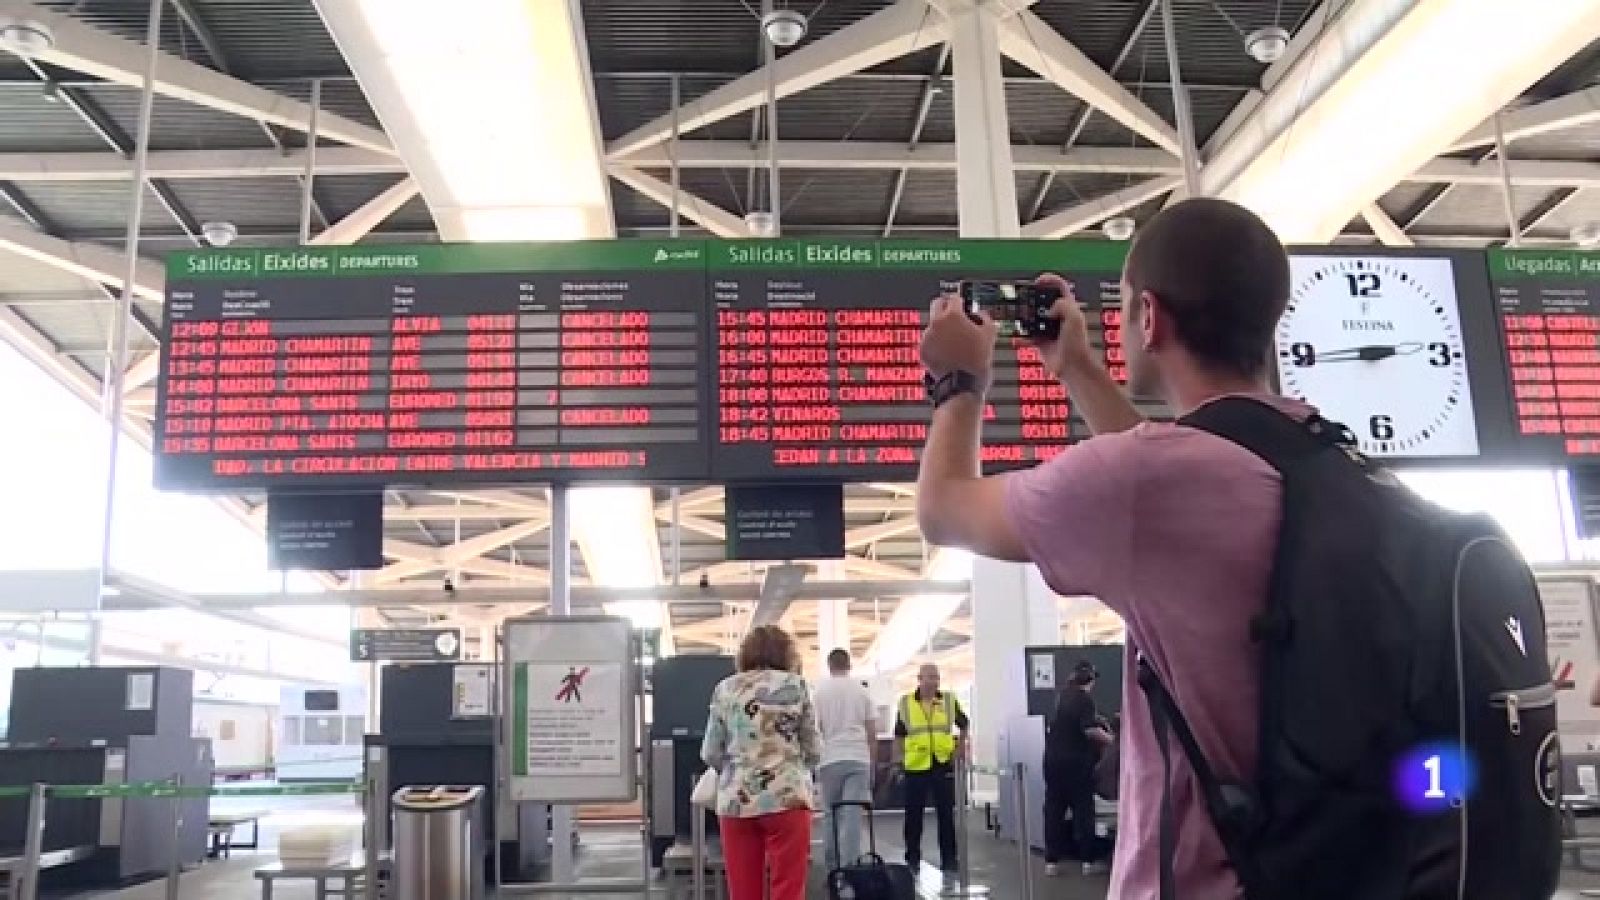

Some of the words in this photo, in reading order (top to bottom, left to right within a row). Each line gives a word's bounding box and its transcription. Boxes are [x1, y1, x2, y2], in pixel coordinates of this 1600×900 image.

[187, 255, 251, 271] Salidas
[264, 253, 328, 270] Eixides
[339, 254, 419, 269] DEPARTURES
[729, 246, 794, 262] Salidas
[806, 245, 872, 261] Eixides
[883, 249, 960, 262] DEPARTURES
[1505, 254, 1571, 275] Llegadas
[1343, 273, 1381, 297] 12
[392, 316, 441, 332] ALVIA
[561, 311, 650, 328] CANCELADO
[719, 310, 767, 326] 15:45
[769, 310, 827, 326] MADRID
[835, 309, 921, 325] CHAMARTIN
[220, 339, 278, 356] MADRID
[392, 335, 421, 351] AVE
[561, 331, 650, 347] CANCELADO
[769, 329, 829, 345] MADRID
[837, 329, 922, 344] CHAMARTIN
[218, 359, 276, 374] MADRID
[391, 354, 421, 370] AVE
[561, 351, 650, 366] CANCELADO
[771, 348, 829, 363] MADRID
[1291, 342, 1316, 367] 9
[1428, 342, 1451, 367] 3
[217, 378, 276, 393] MADRID
[561, 369, 650, 385] CANCELADO
[772, 368, 830, 382] BURGOS
[216, 396, 301, 412] BARCELONA
[310, 395, 358, 410] SANTS
[389, 393, 456, 408] EUROMED
[772, 387, 830, 402] MADRID
[839, 386, 926, 401] CHAMARTIN
[214, 416, 273, 432] MADRID
[328, 413, 385, 429] ATOCHA
[389, 413, 419, 429] AVE
[561, 409, 650, 424] CANCELADO
[719, 407, 769, 421] 18:42
[773, 406, 841, 421] VINAROS
[719, 426, 769, 441] 18:45
[773, 425, 831, 440] MADRID
[840, 424, 927, 440] CHAMARTIN
[1369, 414, 1394, 440] 6
[214, 435, 300, 451] BARCELONA
[307, 434, 357, 449] SANTS
[388, 432, 456, 448] EUROMED
[291, 456, 399, 473] CIRCULACION
[405, 454, 454, 471] ENTRE
[463, 452, 542, 469] VALENCIA
[568, 450, 630, 467] MADRID
[846, 446, 866, 463] LA
[876, 446, 916, 462] ZONA
